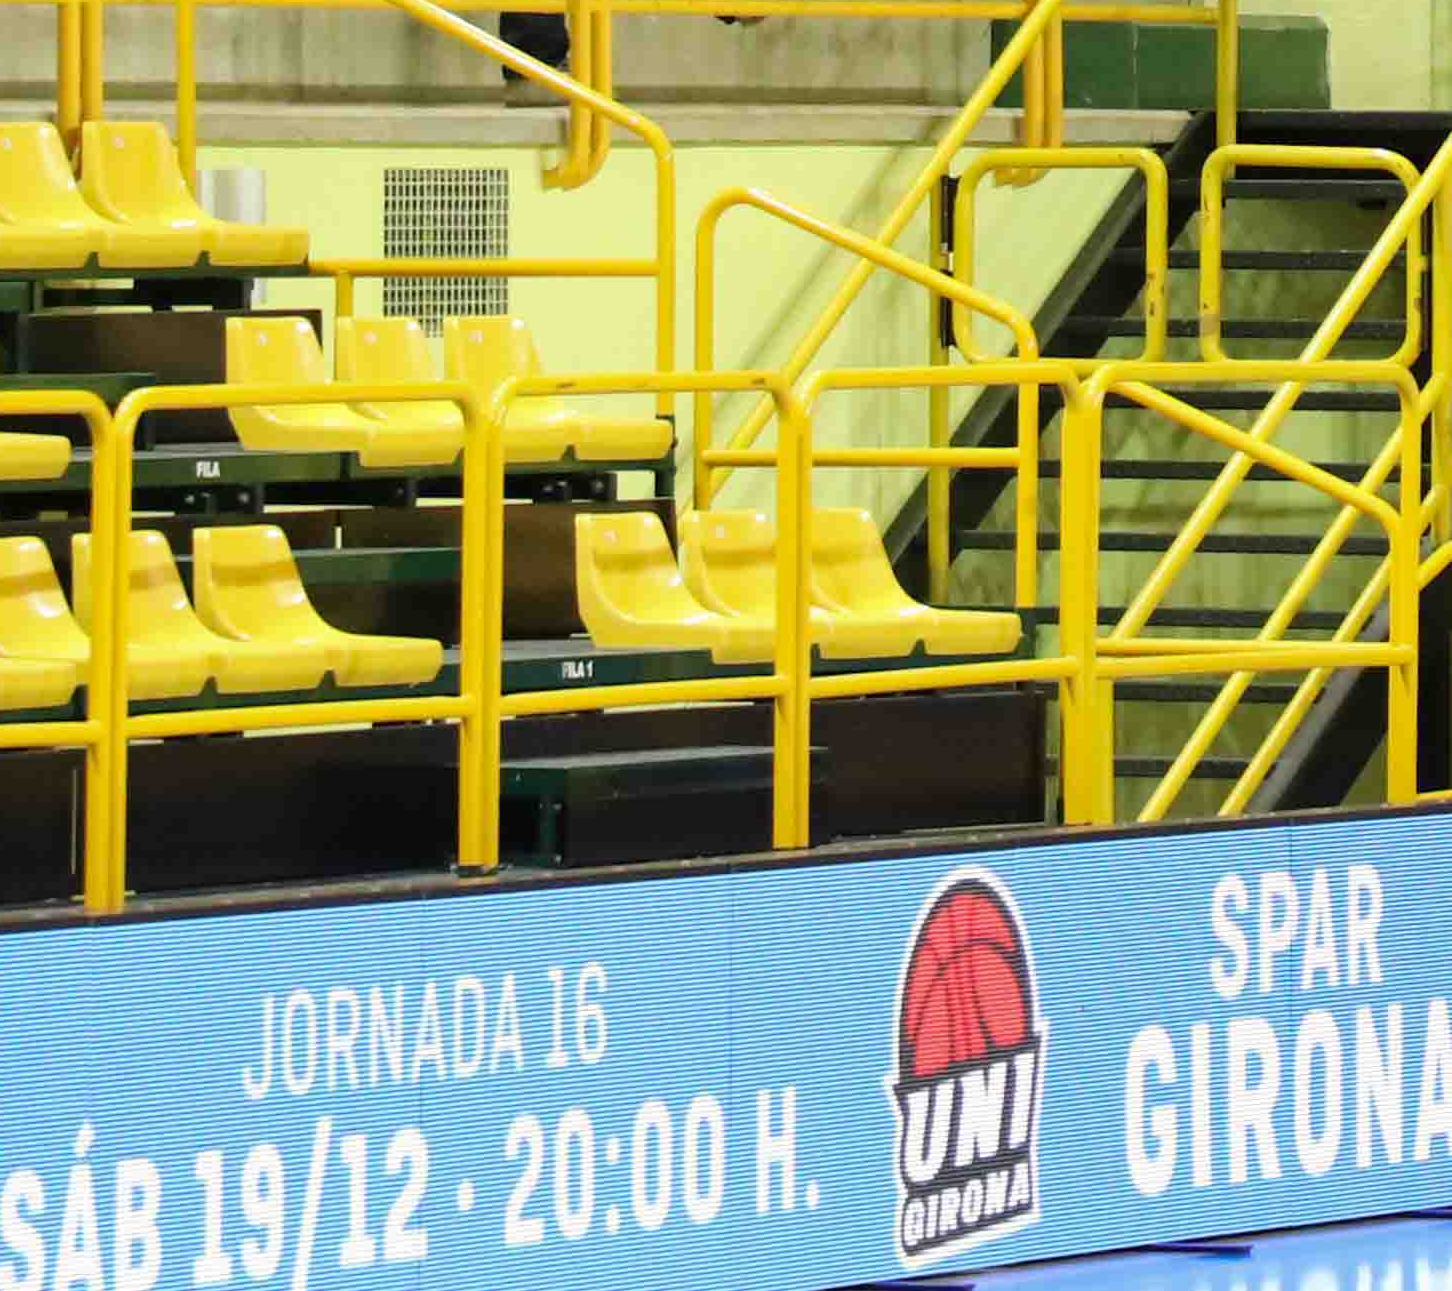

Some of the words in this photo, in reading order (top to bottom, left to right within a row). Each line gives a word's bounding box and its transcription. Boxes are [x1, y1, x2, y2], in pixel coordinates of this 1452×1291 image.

[196, 461, 220, 478] FILA
[1207, 863, 1386, 998] SPAR
[242, 970, 525, 1101] JORNADA
[546, 961, 609, 1070] 16
[902, 1050, 1038, 1184] UNI
[192, 1115, 430, 1291] 19/12
[502, 1094, 725, 1248] 20:00
[754, 1083, 822, 1216] H.
[902, 1161, 1032, 1247] GIRONA
